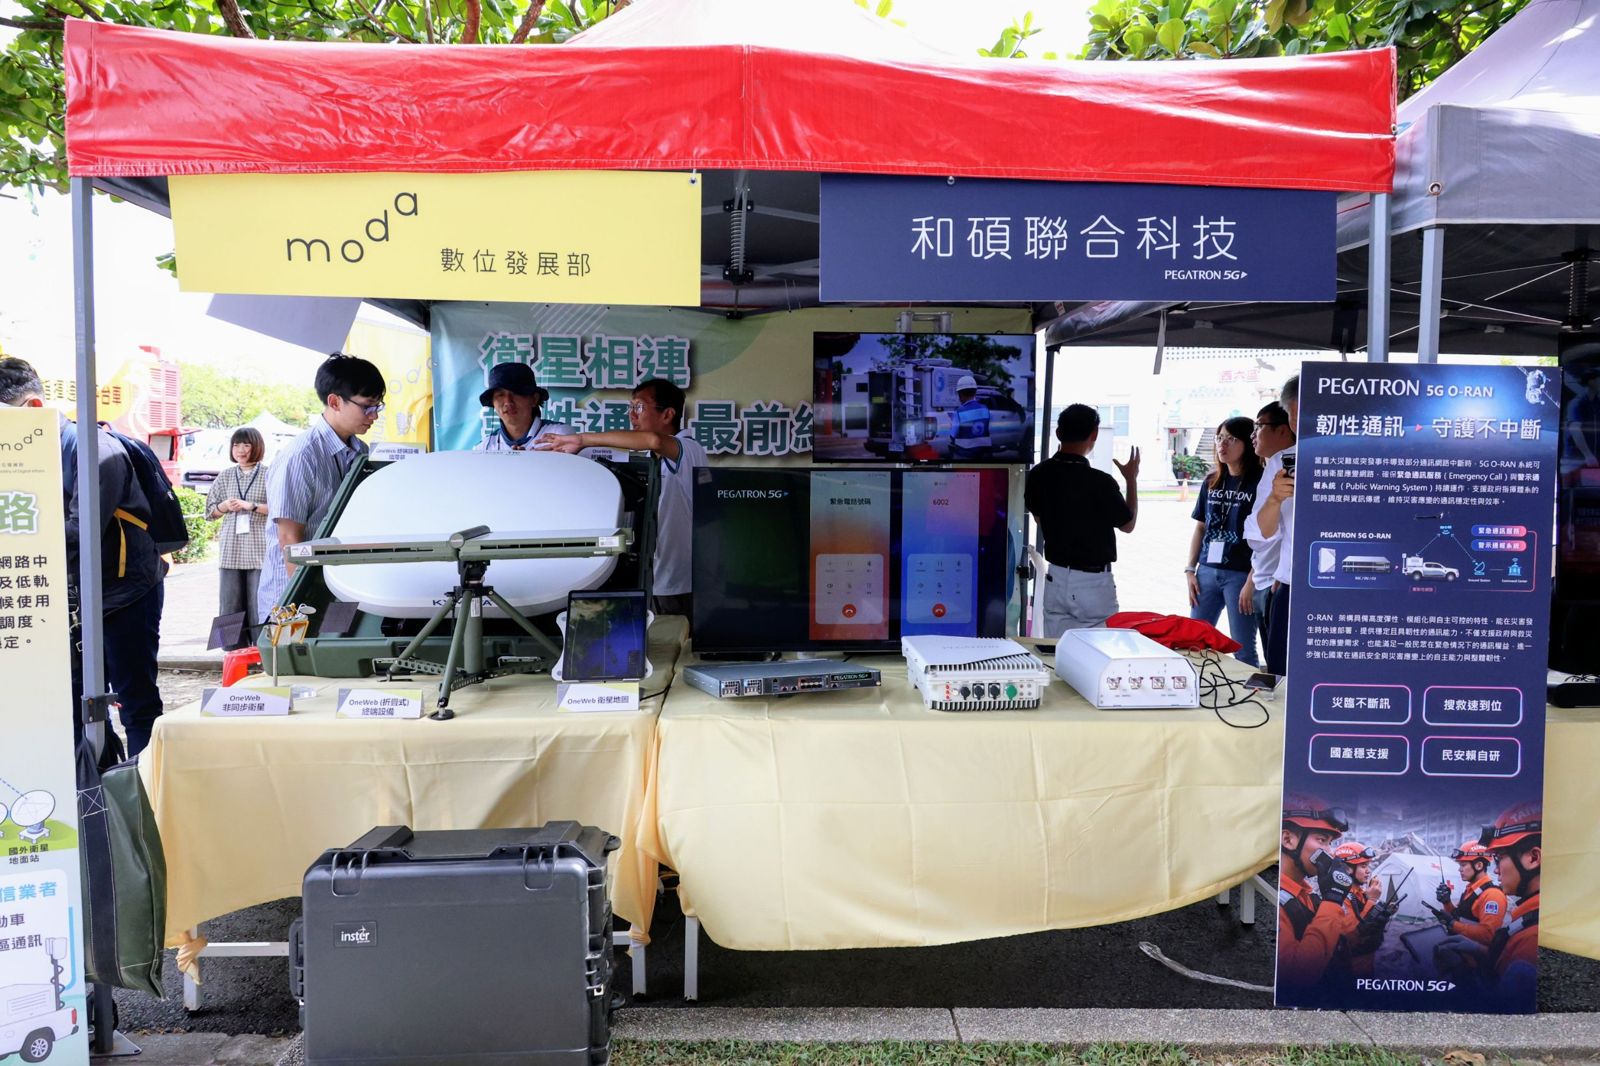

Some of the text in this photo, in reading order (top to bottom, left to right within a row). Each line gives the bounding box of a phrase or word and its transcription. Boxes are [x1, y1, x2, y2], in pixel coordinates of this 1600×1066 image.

[287, 190, 419, 264] moda
[910, 214, 1239, 261] 和碩聯合科技
[440, 248, 592, 277] 數位發展部
[1164, 269, 1241, 280] PEGATRON 5G
[480, 333, 689, 387] 衛星相連
[1317, 377, 1493, 398] PEGATRON 5G O-RAN
[1315, 414, 1542, 441] 韌性通訊 守護不中斷
[1491, 460, 1517, 469] O-RAN
[717, 489, 783, 498] PEGATRON 5G
[1369, 483, 1401, 493] Warning
[1320, 531, 1357, 539] PEGATRON
[1306, 613, 1333, 622] O-RAN
[229, 694, 261, 702] OneWeb
[348, 698, 379, 706] OneWeb
[567, 697, 597, 705] OneWeb
[1331, 696, 1391, 710] 災臨不斷訊
[222, 702, 265, 712] 非同步衛星
[1443, 699, 1502, 712] 搜救速到位
[1329, 747, 1389, 760] 國產穩支援
[1441, 749, 1501, 762] 民安賴自研
[8, 843, 49, 856] 國外衛星
[9, 854, 40, 865] 地面站
[1356, 978, 1447, 992] PEGATRON 5G
